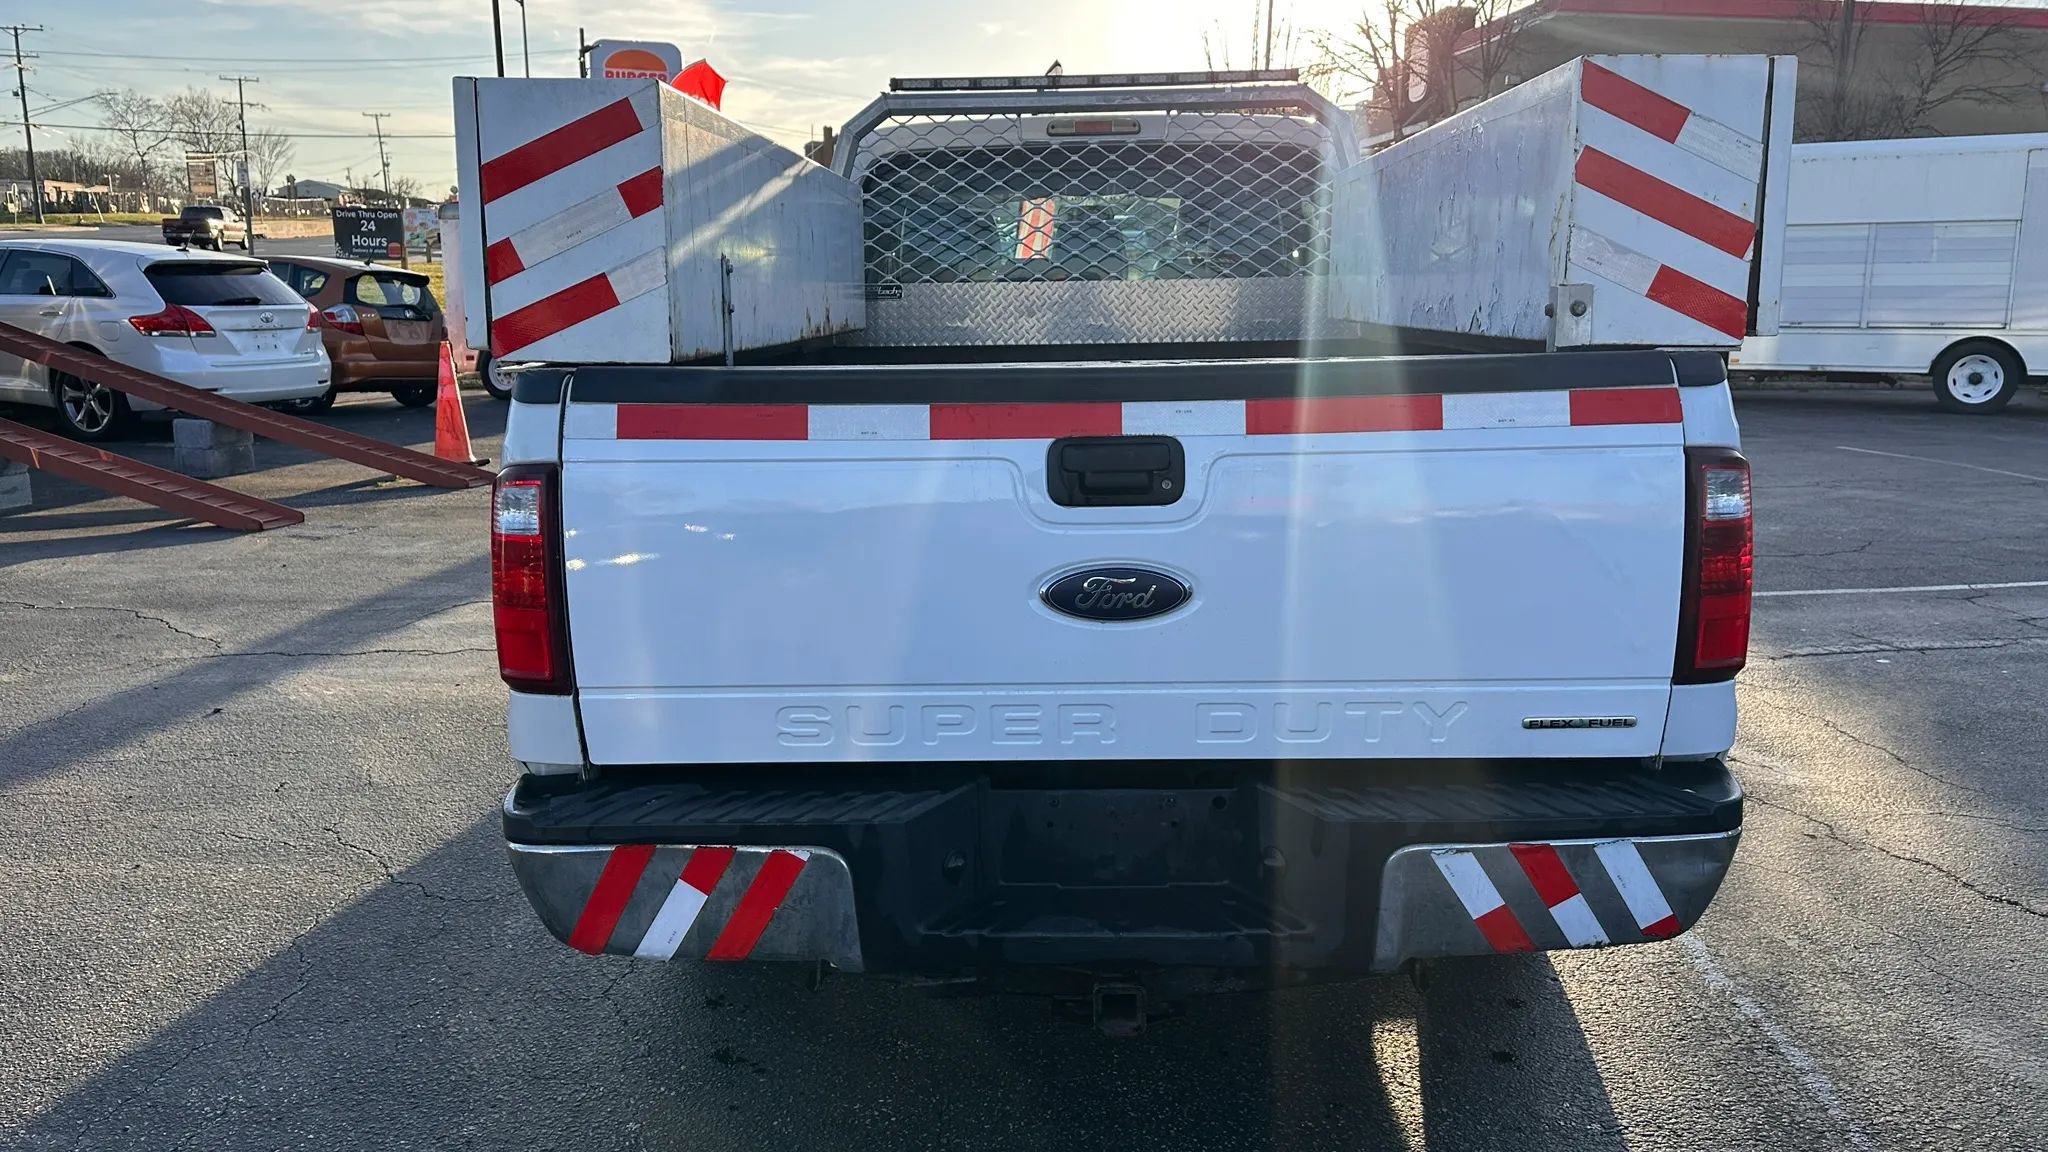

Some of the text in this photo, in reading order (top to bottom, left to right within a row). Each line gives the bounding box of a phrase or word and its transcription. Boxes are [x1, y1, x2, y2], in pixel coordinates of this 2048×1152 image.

[336, 210, 398, 219] Drive Thru Open
[360, 220, 376, 231] 24
[352, 234, 388, 246] Hours
[1075, 577, 1156, 609] Ford
[775, 701, 1468, 745] SUPER DUTY
[1529, 718, 1634, 728] FLEX FUEL
